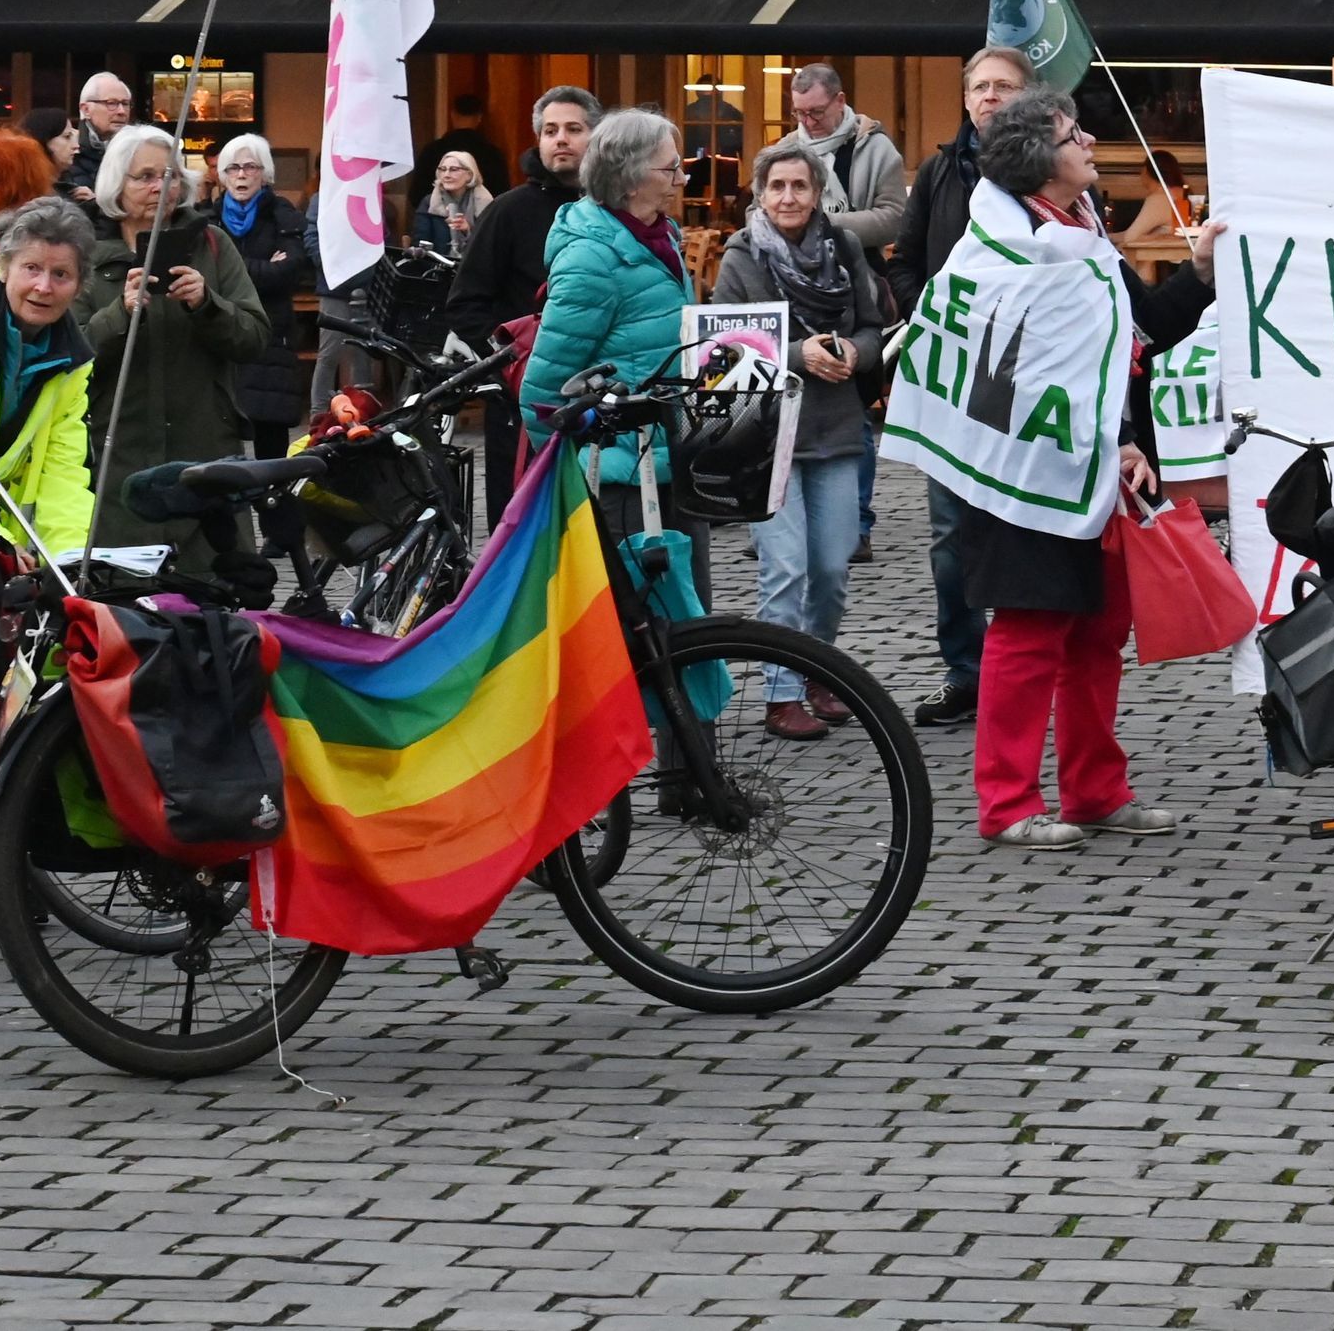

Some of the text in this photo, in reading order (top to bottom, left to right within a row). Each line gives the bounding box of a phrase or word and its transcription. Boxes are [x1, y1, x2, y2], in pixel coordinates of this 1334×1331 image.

[704, 316, 778, 332] There is no
